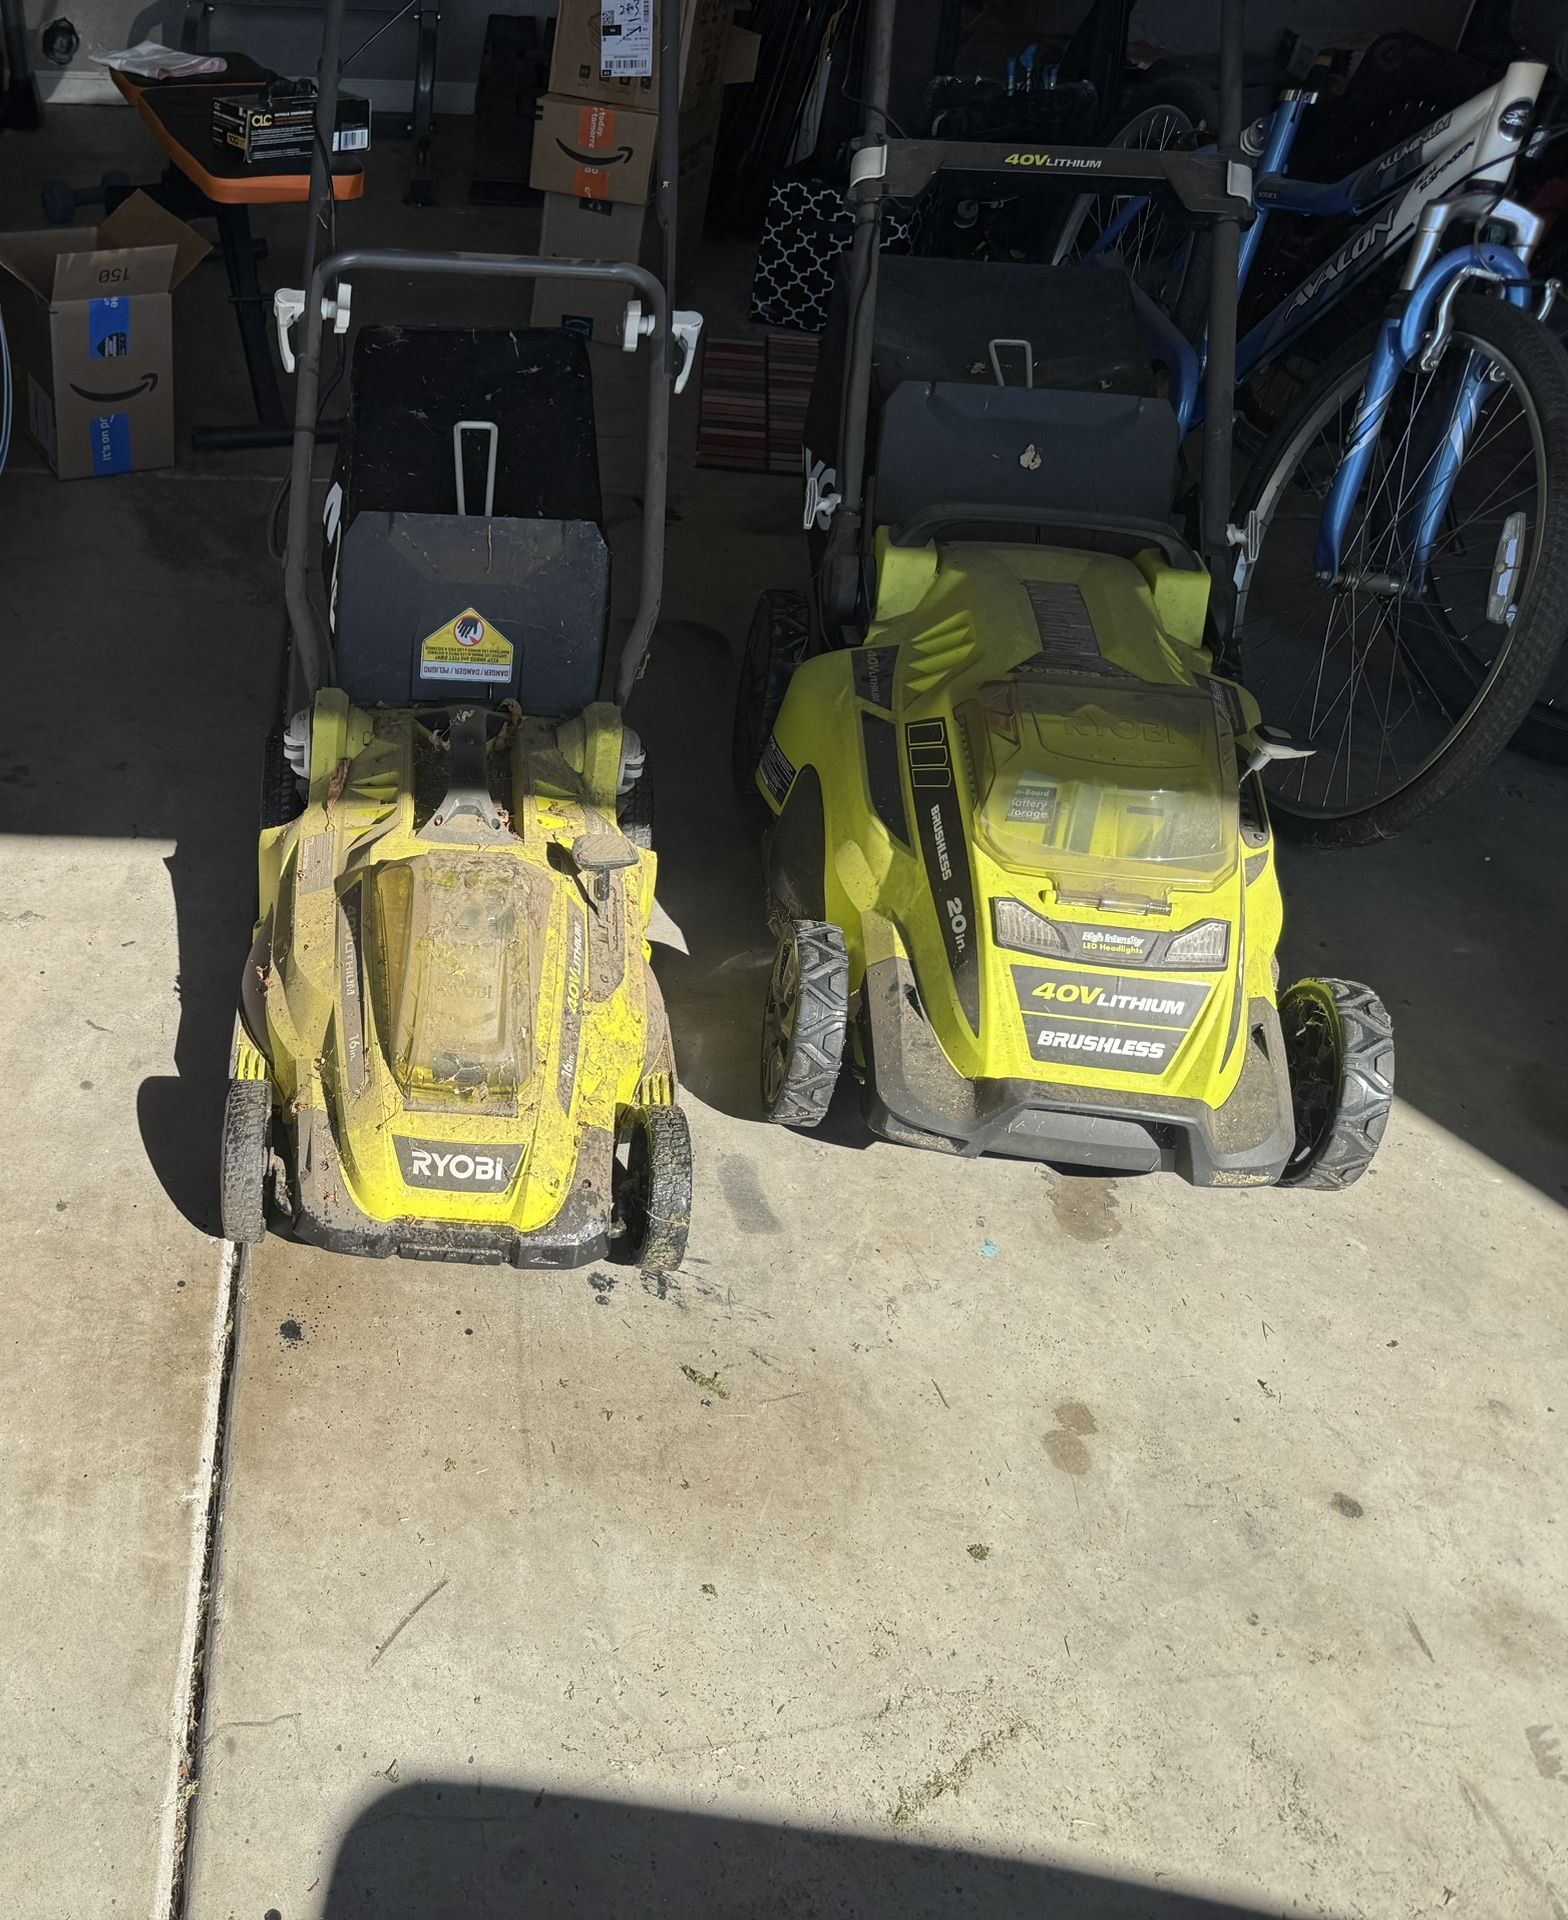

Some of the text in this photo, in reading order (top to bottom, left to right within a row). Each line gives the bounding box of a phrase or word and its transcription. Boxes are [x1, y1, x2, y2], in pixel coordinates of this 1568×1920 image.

[98, 267, 130, 284] 150
[1284, 207, 1396, 321] AVALON
[101, 430, 110, 444] on
[454, 667, 480, 676] DANGER
[930, 803, 952, 881] BRUSHLESS
[1082, 931, 1104, 943] High
[1082, 942, 1143, 955] LED Headlights
[1031, 982, 1185, 1015] 40V LITHIUM
[1037, 1030, 1166, 1059] BRUSHLESS
[411, 1150, 503, 1181] RYOBI
